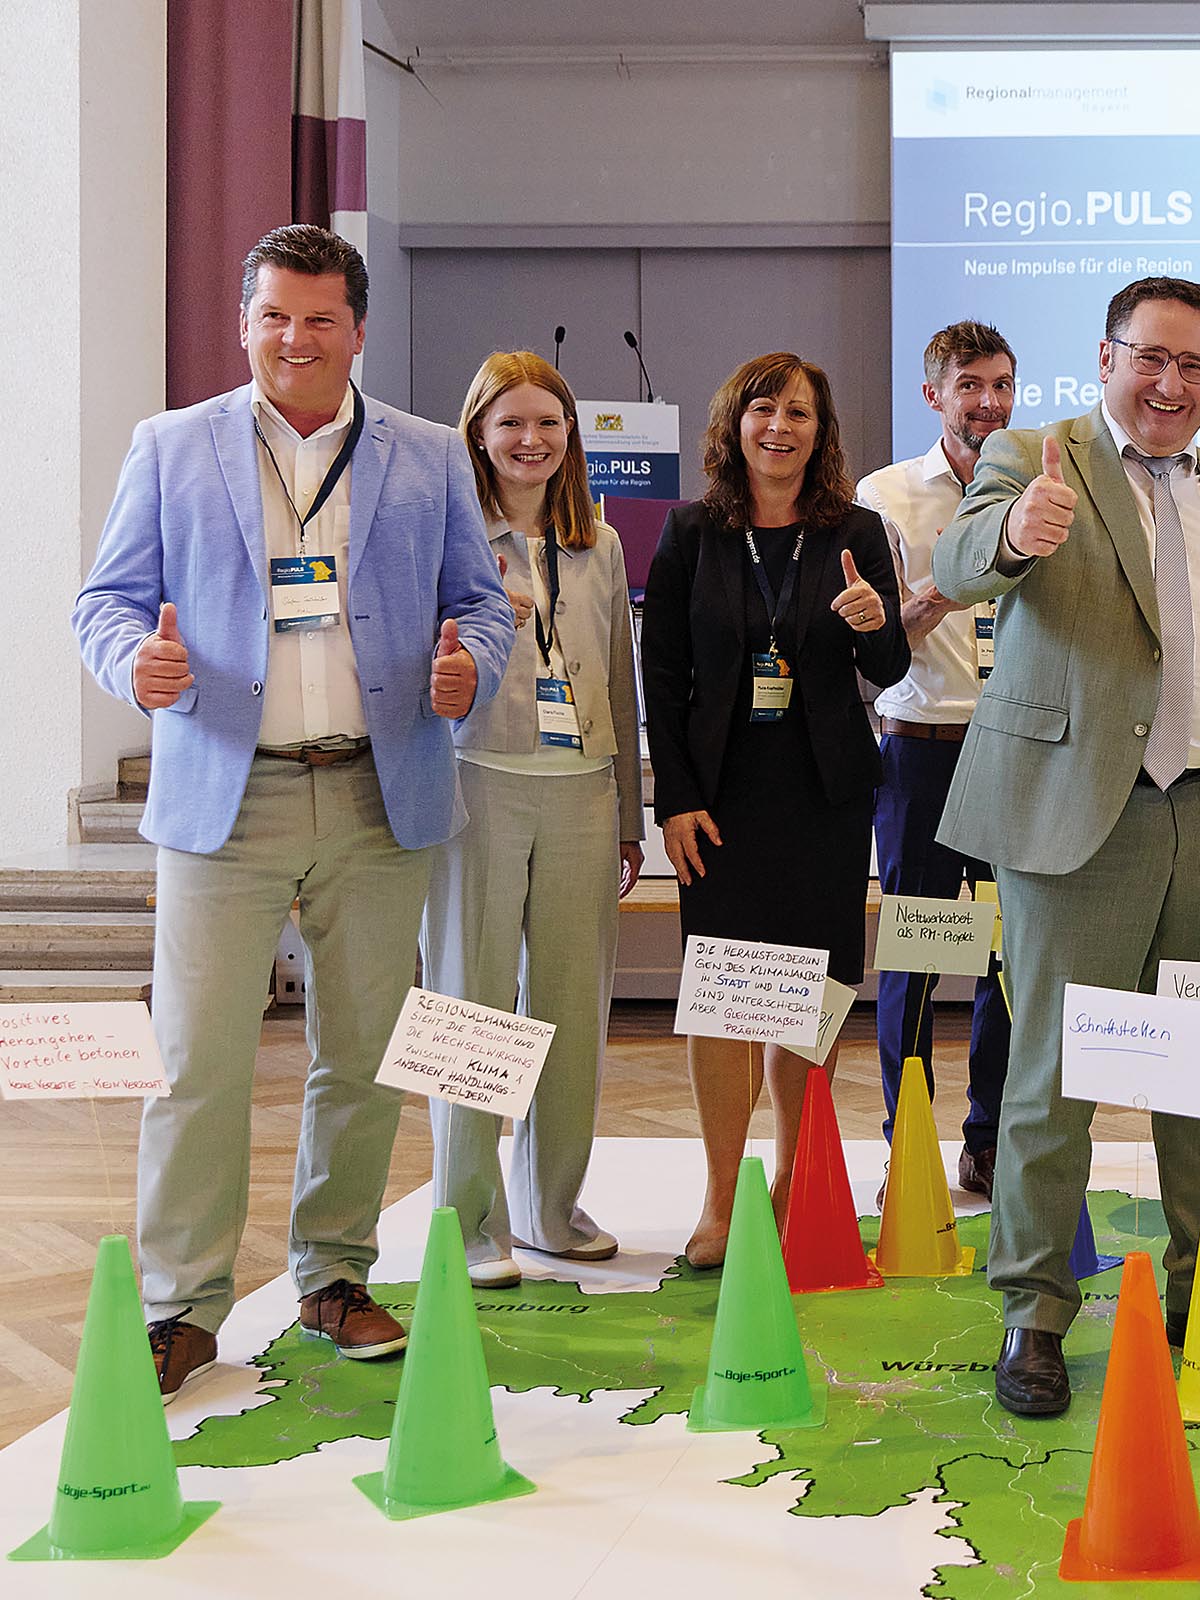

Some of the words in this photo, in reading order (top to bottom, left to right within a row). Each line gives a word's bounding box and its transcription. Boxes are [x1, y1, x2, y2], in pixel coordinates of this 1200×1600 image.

[966, 86, 1128, 101] Regionalmanagement
[964, 191, 1193, 235] Regio.PULS
[964, 259, 1008, 276] Neue
[1012, 259, 1076, 278] Impulse
[1080, 258, 1104, 274] für
[1107, 257, 1132, 274] die
[1137, 257, 1193, 276] Region
[1016, 377, 1042, 407] ie
[587, 460, 652, 477] gio.PULS
[897, 927, 914, 939] als
[696, 942, 716, 954] DIE
[695, 959, 722, 970] GEN
[725, 962, 746, 973] DES
[750, 965, 826, 982] KLIMAWANDELS
[694, 988, 725, 1001] SIND
[714, 974, 751, 989] STADT
[754, 981, 773, 991] UND
[779, 983, 810, 997] LAND
[689, 1002, 718, 1015] ABER
[410, 1011, 444, 1026] SIEHT
[446, 1021, 467, 1033] DIE
[472, 1026, 513, 1045] REGION
[513, 1037, 536, 1050] UND
[723, 1023, 785, 1039] PRÄGNANT
[1069, 1012, 1172, 1041] Schnittstellen
[406, 1025, 422, 1039] DIE
[432, 1032, 535, 1068] WECHSELWIRKUNG
[1, 1050, 73, 1070] Vorteile
[80, 1047, 140, 1061] betonen
[392, 1057, 446, 1078] ANDEREN
[406, 1043, 457, 1064] ZWISCHEN
[466, 1058, 509, 1079] KLIMA
[438, 1083, 494, 1104] FELDERN
[882, 1360, 998, 1372] Würzb
